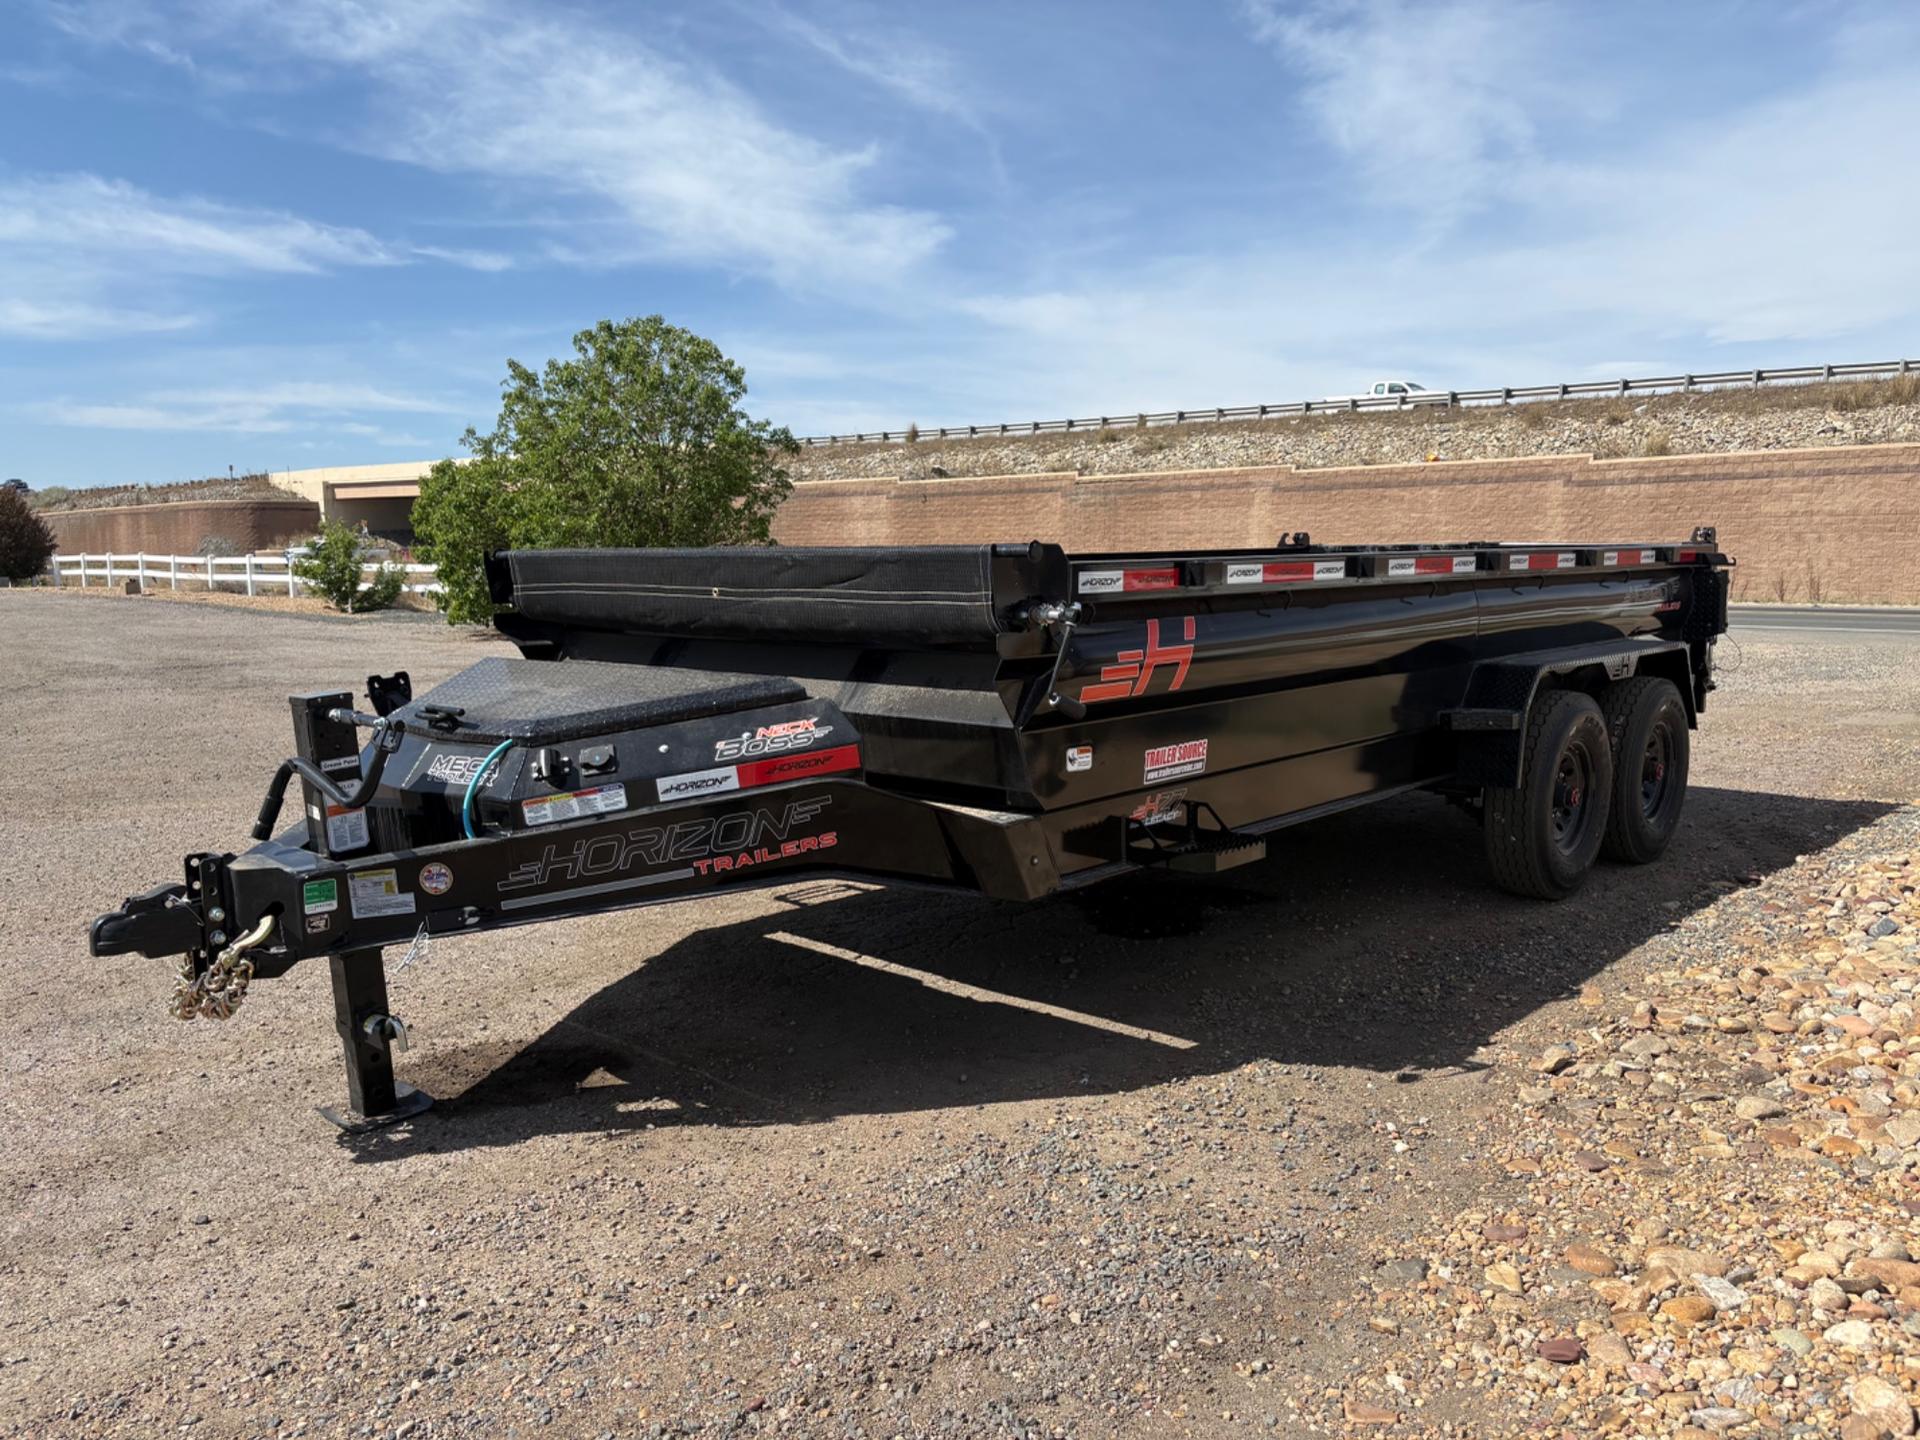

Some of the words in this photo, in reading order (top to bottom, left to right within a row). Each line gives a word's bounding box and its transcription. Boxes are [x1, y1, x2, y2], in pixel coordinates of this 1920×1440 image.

[756, 718, 816, 739] NECK
[715, 732, 816, 761] BOSS
[1146, 747, 1176, 768] TRAILER
[1178, 741, 1207, 761] SOURCE
[324, 761, 341, 769] Grease
[344, 757, 357, 766] Point
[769, 757, 828, 774] HORIZON
[667, 776, 726, 794] HORIZON
[537, 803, 796, 884] HORIZON
[694, 832, 838, 876] TRAILERS
